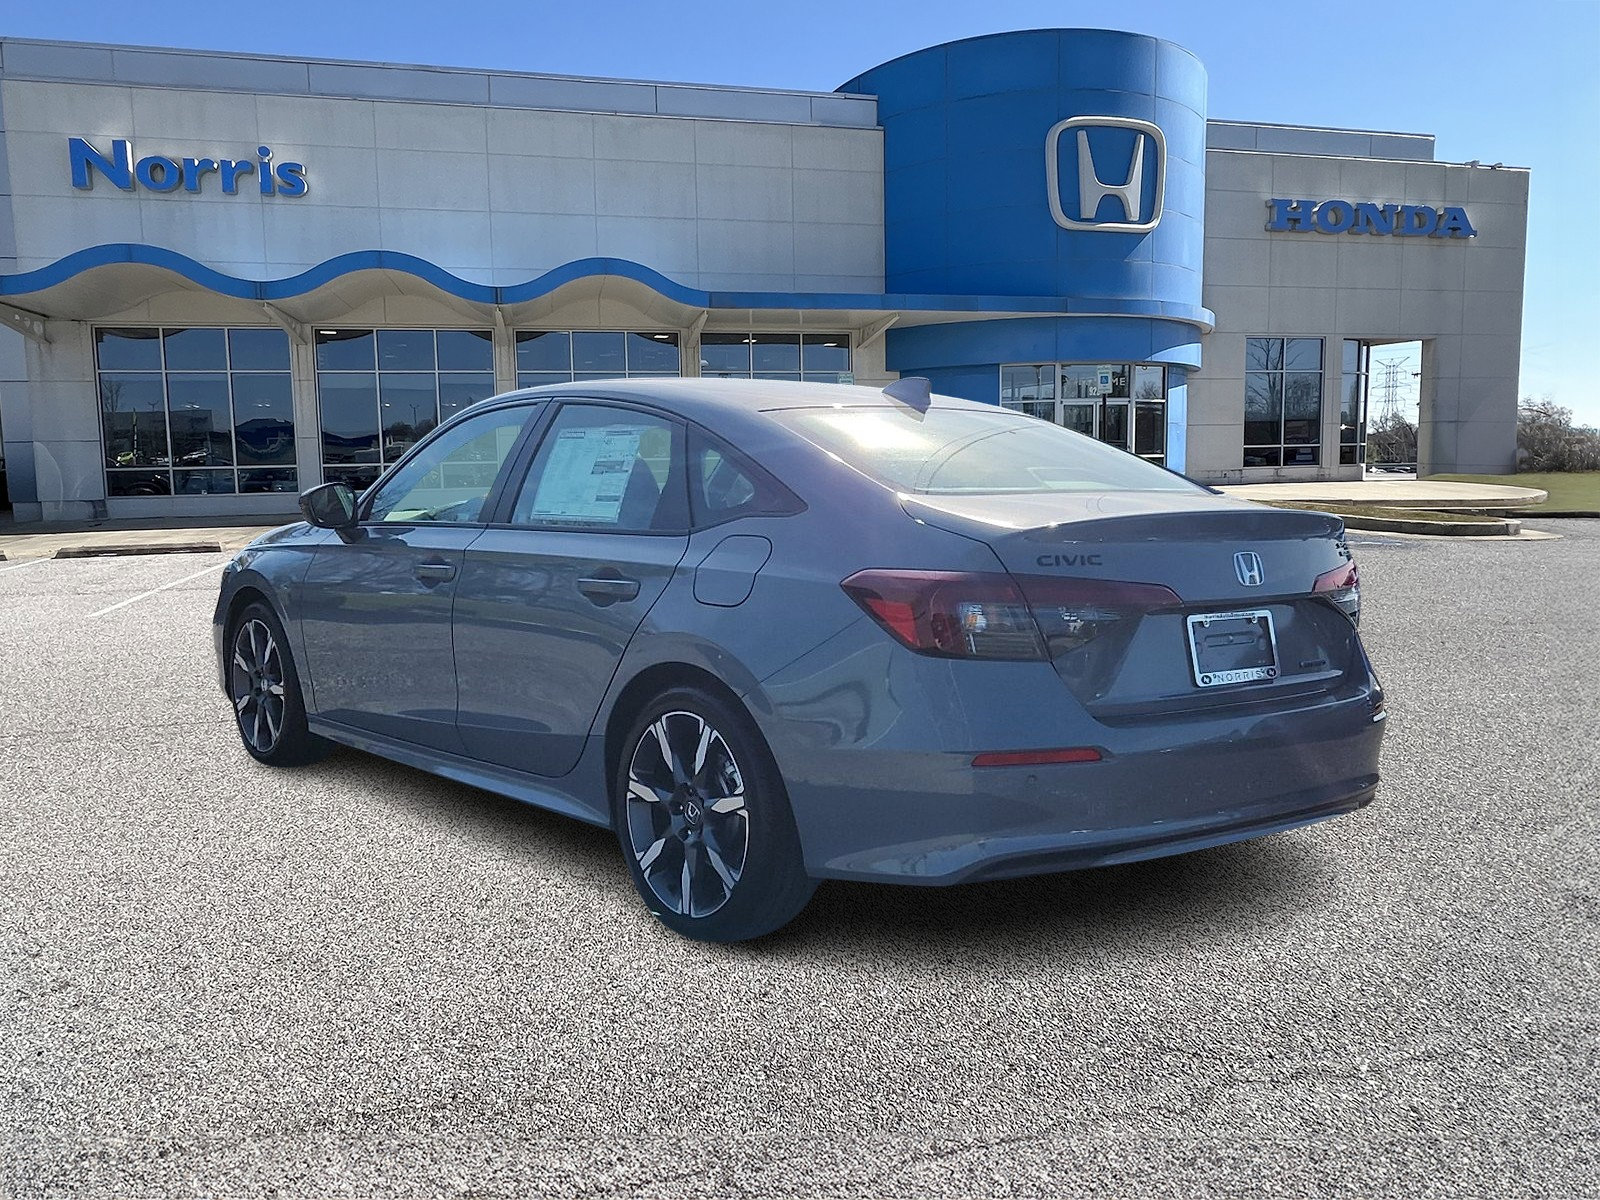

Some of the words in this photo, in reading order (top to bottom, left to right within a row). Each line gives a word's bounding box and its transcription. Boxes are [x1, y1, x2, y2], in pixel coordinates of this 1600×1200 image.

[68, 137, 309, 197] Norris
[1265, 198, 1478, 239] HONDA
[1036, 554, 1103, 567] CIVIC
[1217, 670, 1263, 683] NORRIS
